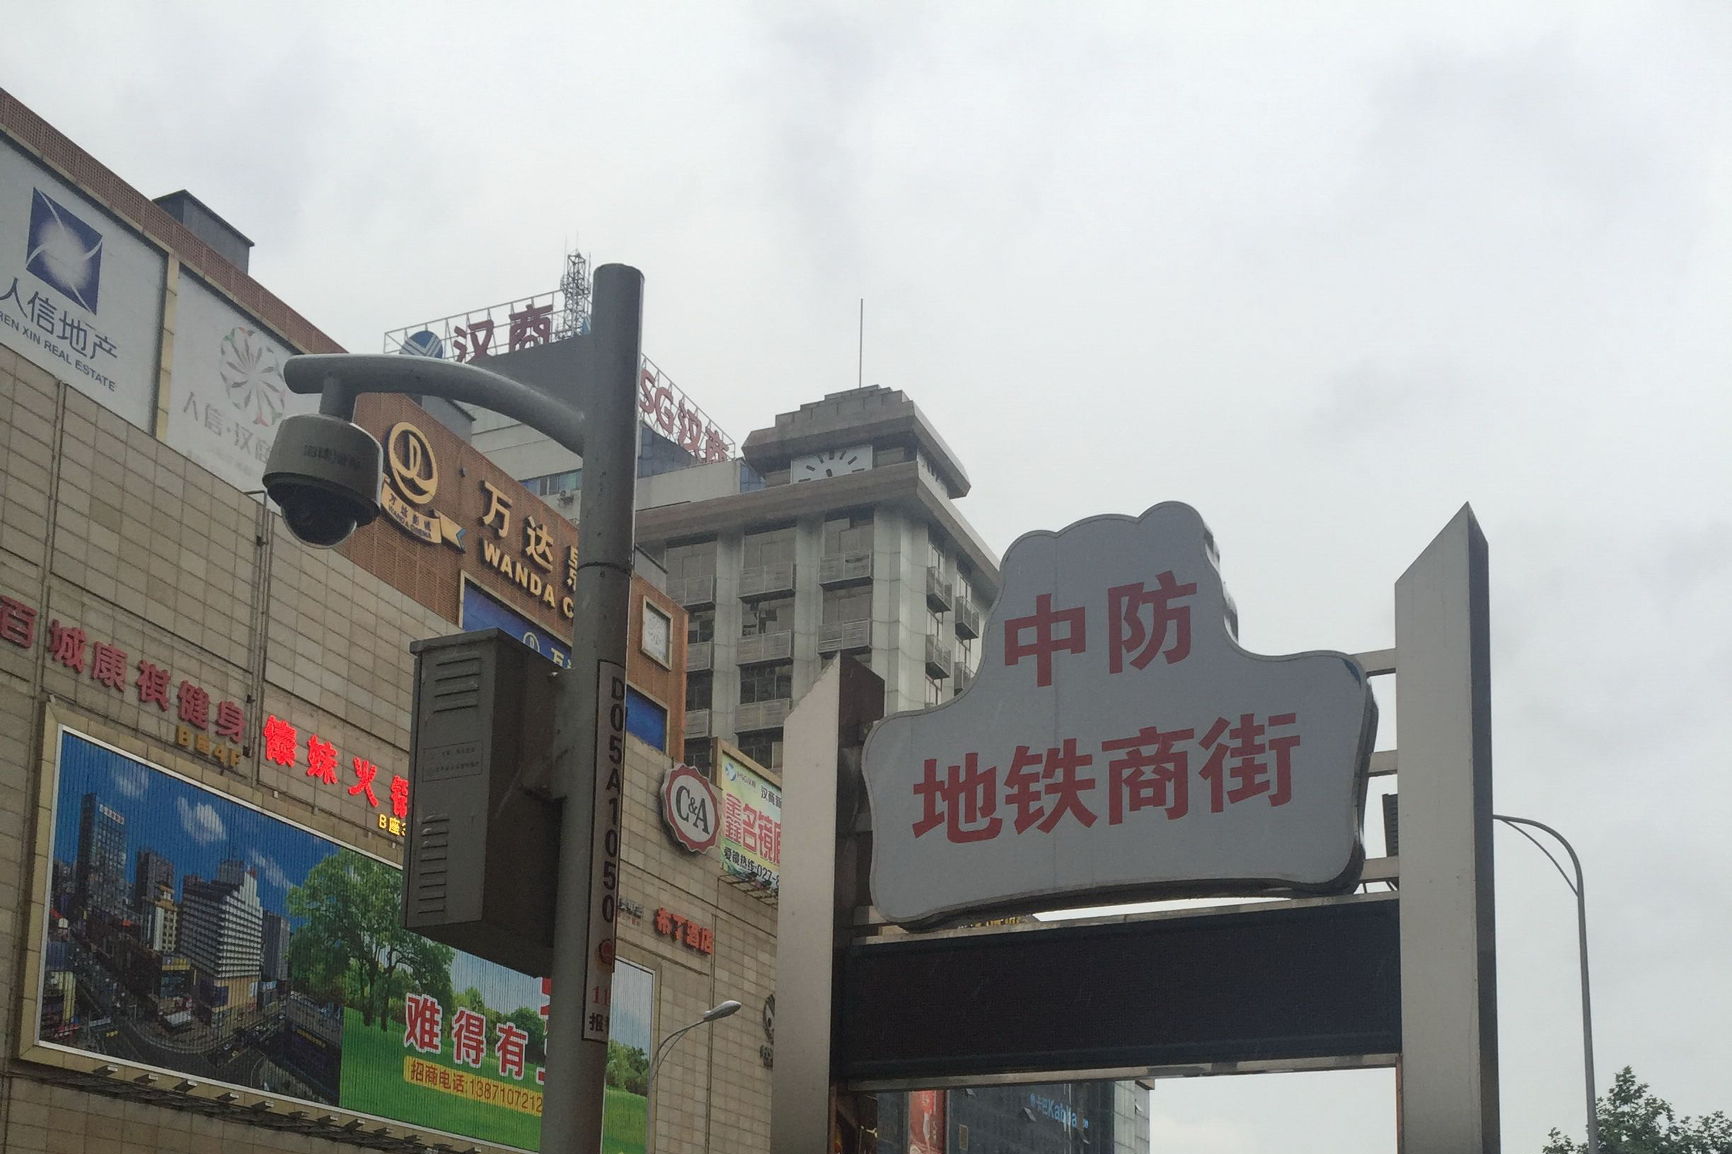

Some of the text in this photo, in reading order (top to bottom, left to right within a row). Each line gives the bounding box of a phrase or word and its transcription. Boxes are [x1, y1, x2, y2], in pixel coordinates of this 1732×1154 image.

[0, 277, 118, 360] 人信地产
[22, 326, 41, 346] XIN
[43, 340, 73, 366] REAL
[74, 360, 117, 392] ESTATE
[484, 540, 556, 609] WANDA
[1004, 570, 1197, 687] 中防
[602, 676, 626, 924] D05A1050
[675, 785, 711, 835] C&A
[912, 712, 1300, 844] 地铁商街
[405, 993, 545, 1084] 难得有
[589, 1012, 611, 1032] 报
